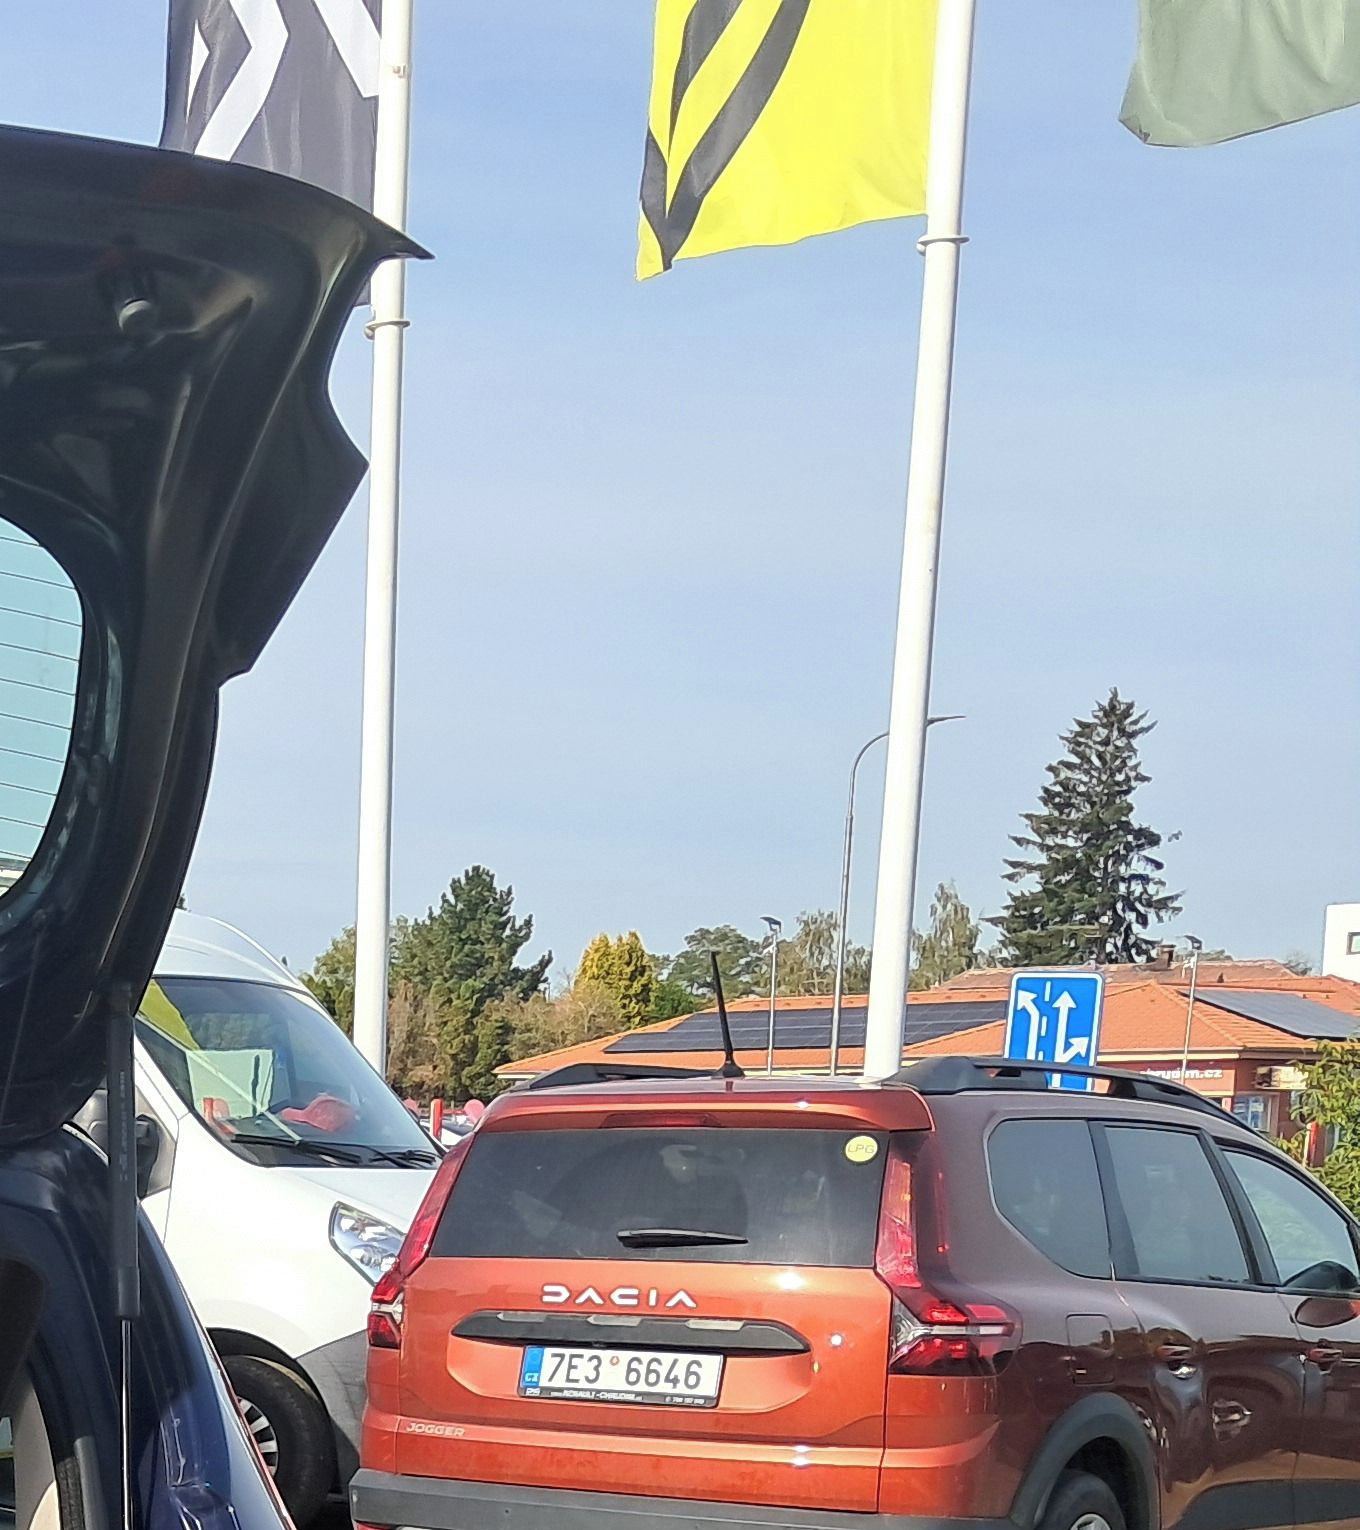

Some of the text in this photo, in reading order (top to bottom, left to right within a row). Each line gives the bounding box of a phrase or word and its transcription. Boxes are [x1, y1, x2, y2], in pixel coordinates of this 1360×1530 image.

[847, 1143, 875, 1154] LPG
[541, 1284, 698, 1309] DACIA
[547, 1352, 703, 1390] 7E3 6646
[406, 1422, 466, 1437] JOGGER
